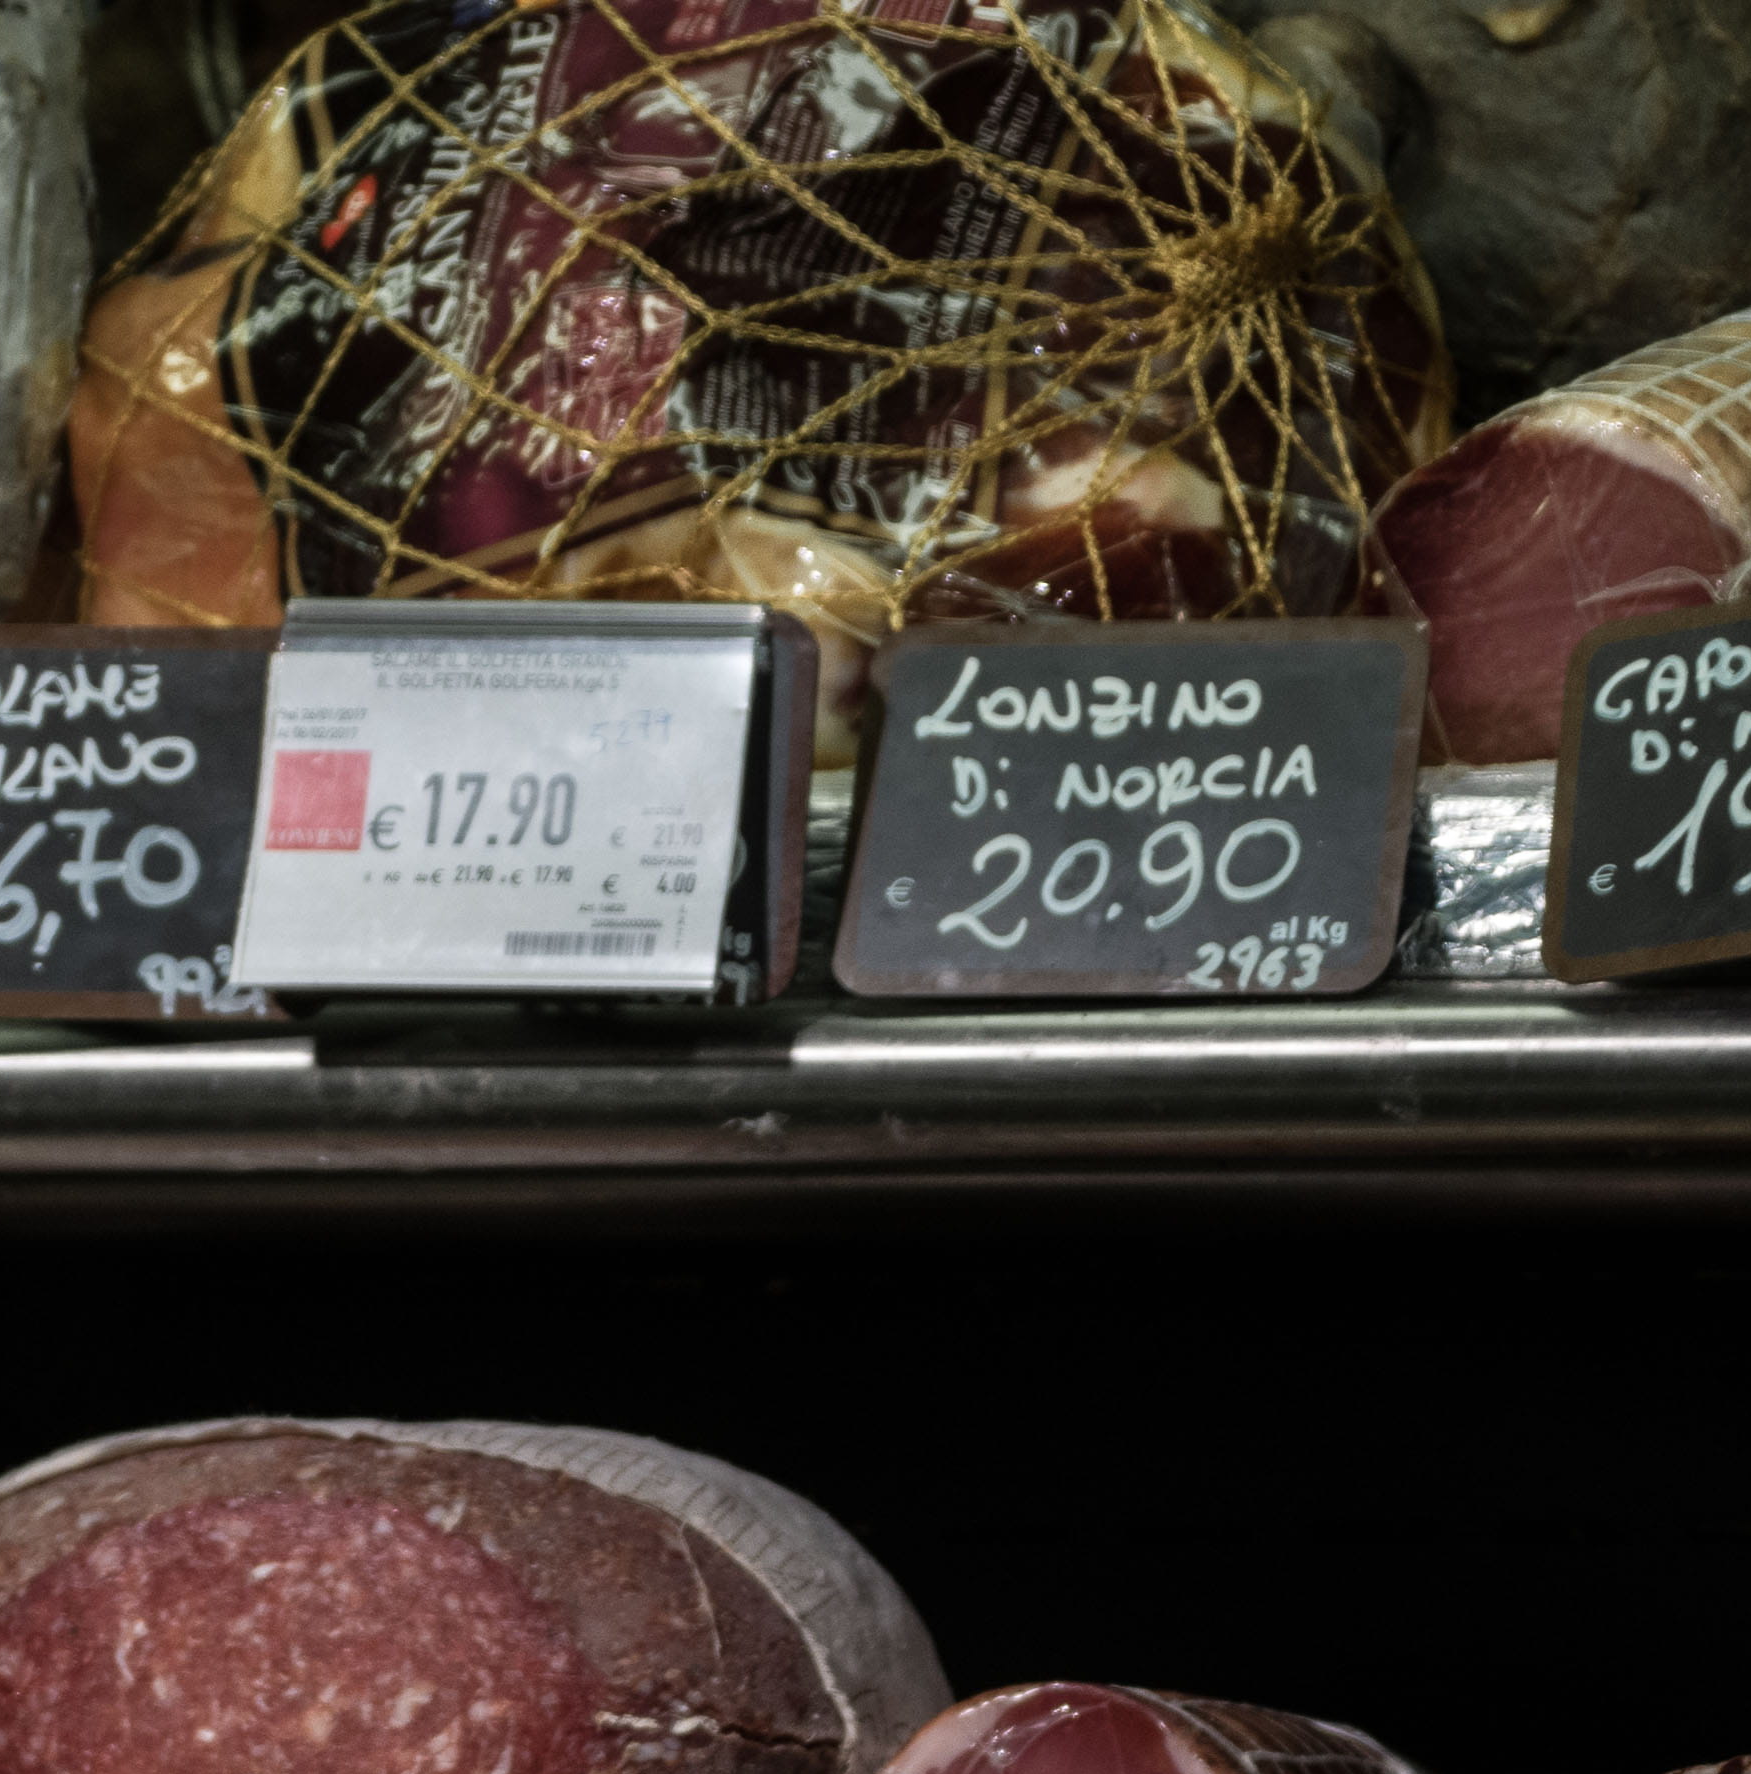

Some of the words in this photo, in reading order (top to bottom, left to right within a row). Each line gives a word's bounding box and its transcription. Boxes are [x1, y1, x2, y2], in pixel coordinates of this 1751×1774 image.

[916, 656, 1261, 739] LONZINO
[1055, 743, 1317, 814] NORCIA
[368, 804, 405, 852] €
[421, 772, 578, 847] 17.90
[652, 822, 703, 847] 21.90
[601, 873, 620, 895] €
[656, 871, 698, 894] 4.00
[885, 876, 916, 908] €
[1588, 864, 1618, 895] €
[1269, 917, 1299, 942] al
[1307, 917, 1349, 944] Kg
